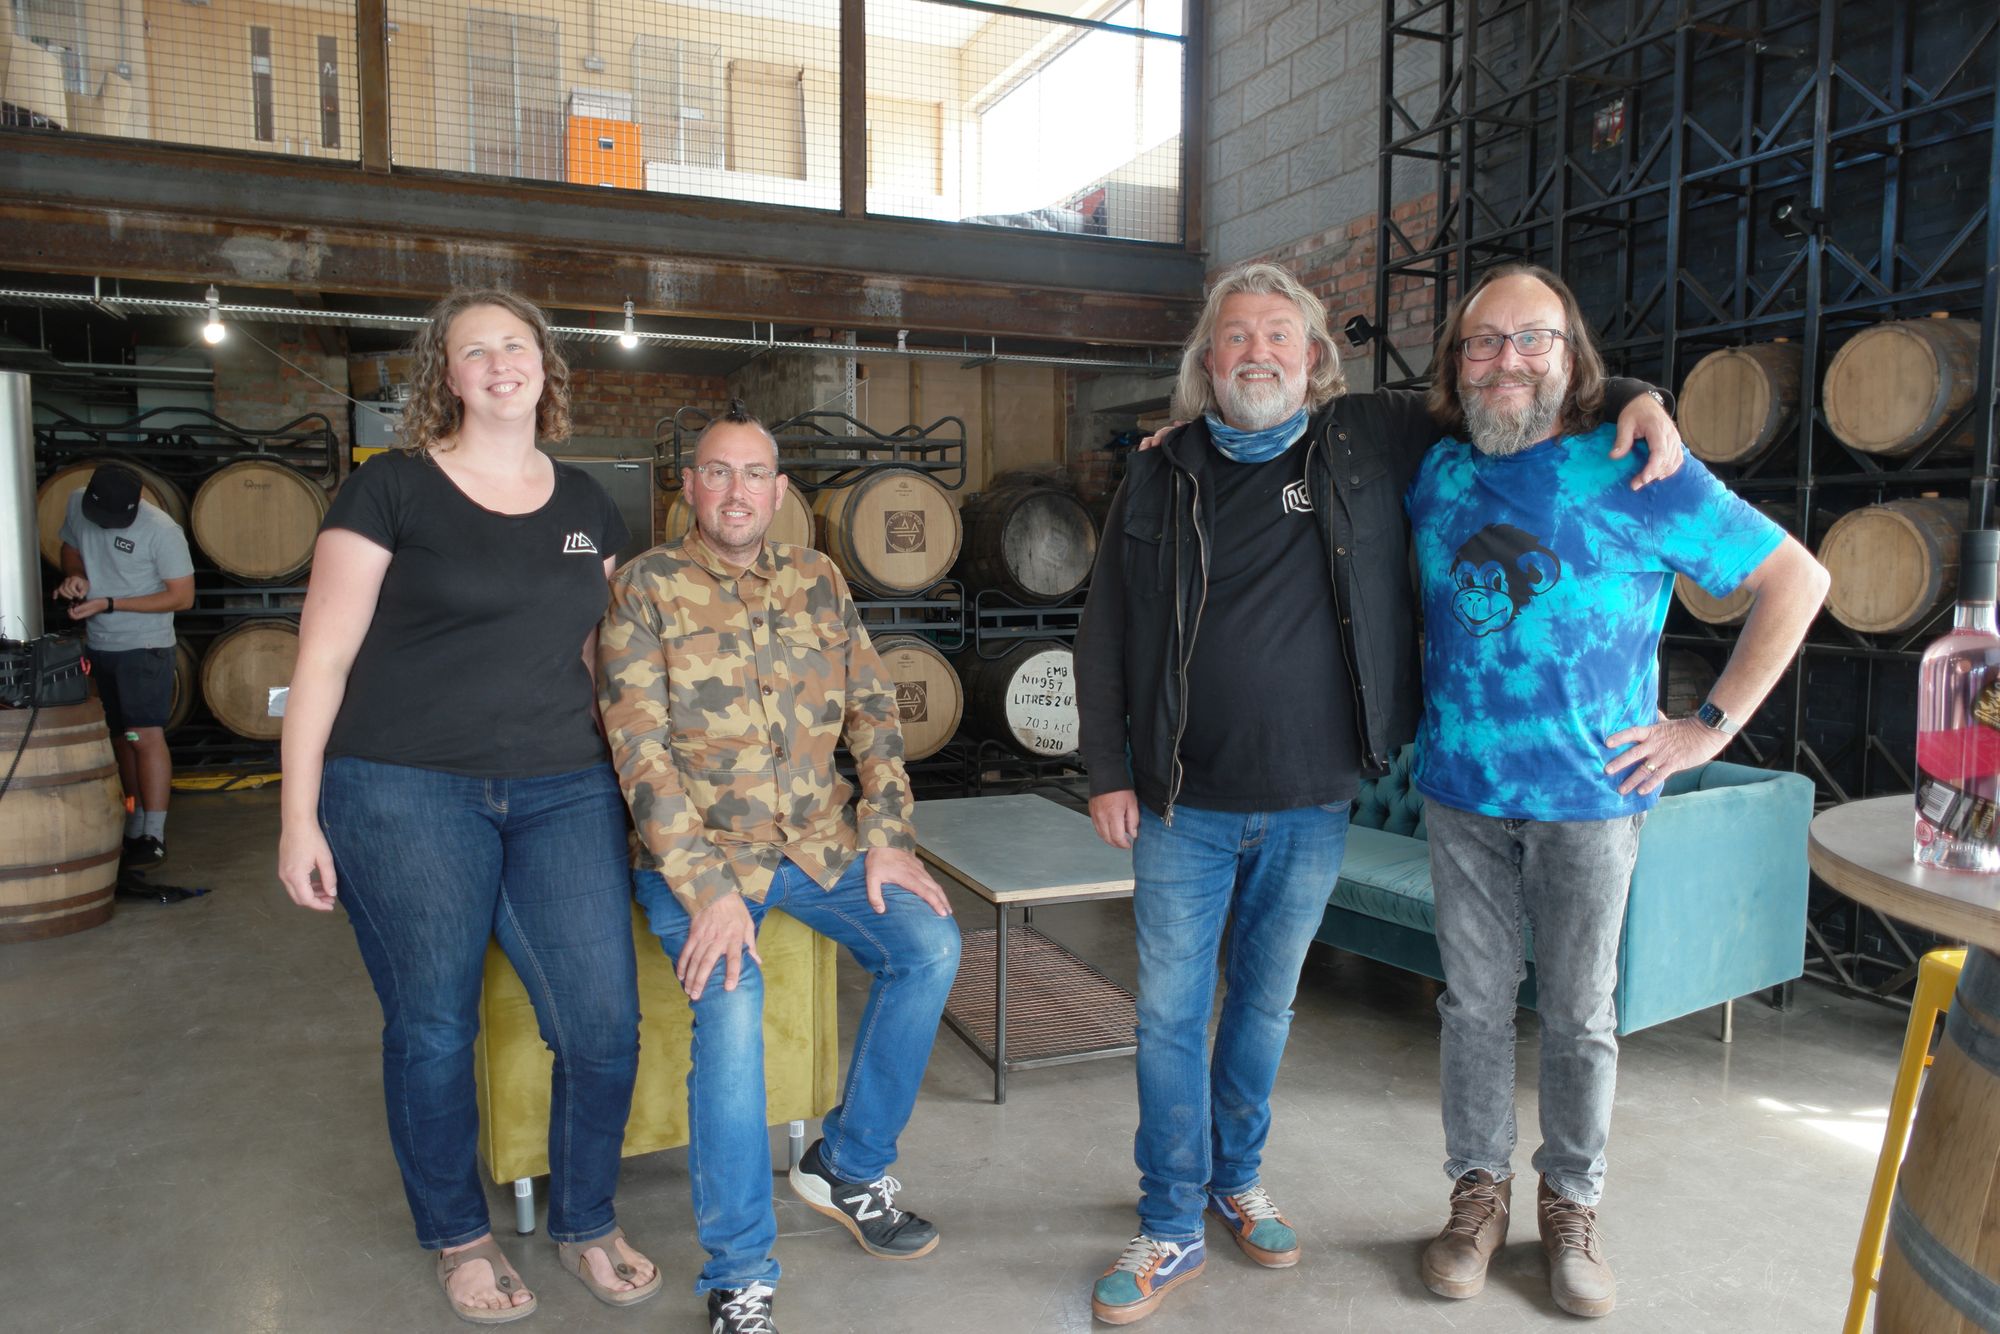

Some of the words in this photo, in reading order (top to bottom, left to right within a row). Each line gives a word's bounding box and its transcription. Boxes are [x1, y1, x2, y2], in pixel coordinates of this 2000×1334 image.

[1046, 666, 1068, 678] EMB
[1014, 693, 1053, 707] LITRES
[1034, 736, 1064, 751] 2020
